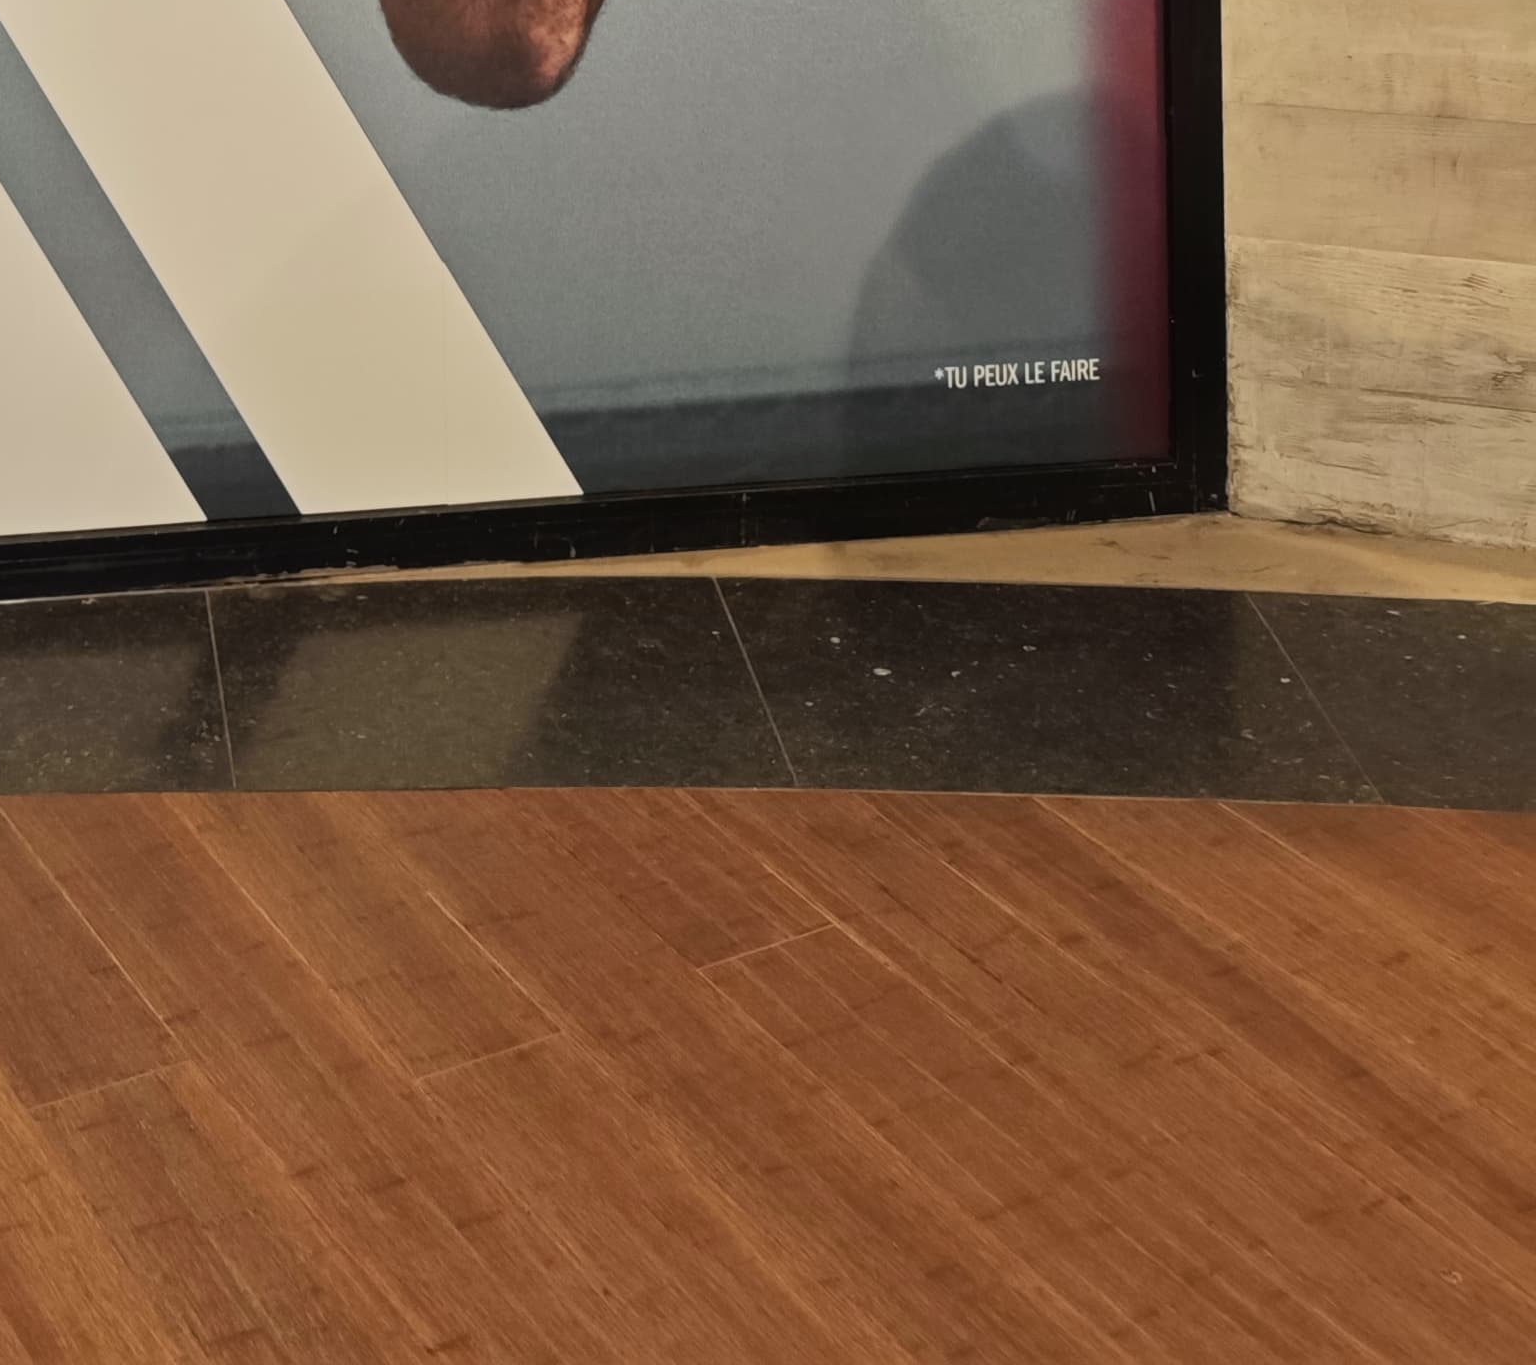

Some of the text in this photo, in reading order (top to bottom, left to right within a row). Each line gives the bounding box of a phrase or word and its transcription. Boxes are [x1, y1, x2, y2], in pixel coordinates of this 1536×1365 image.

[973, 362, 1020, 388] PEUX
[1024, 360, 1046, 385] LE
[1050, 357, 1101, 383] FAIRE
